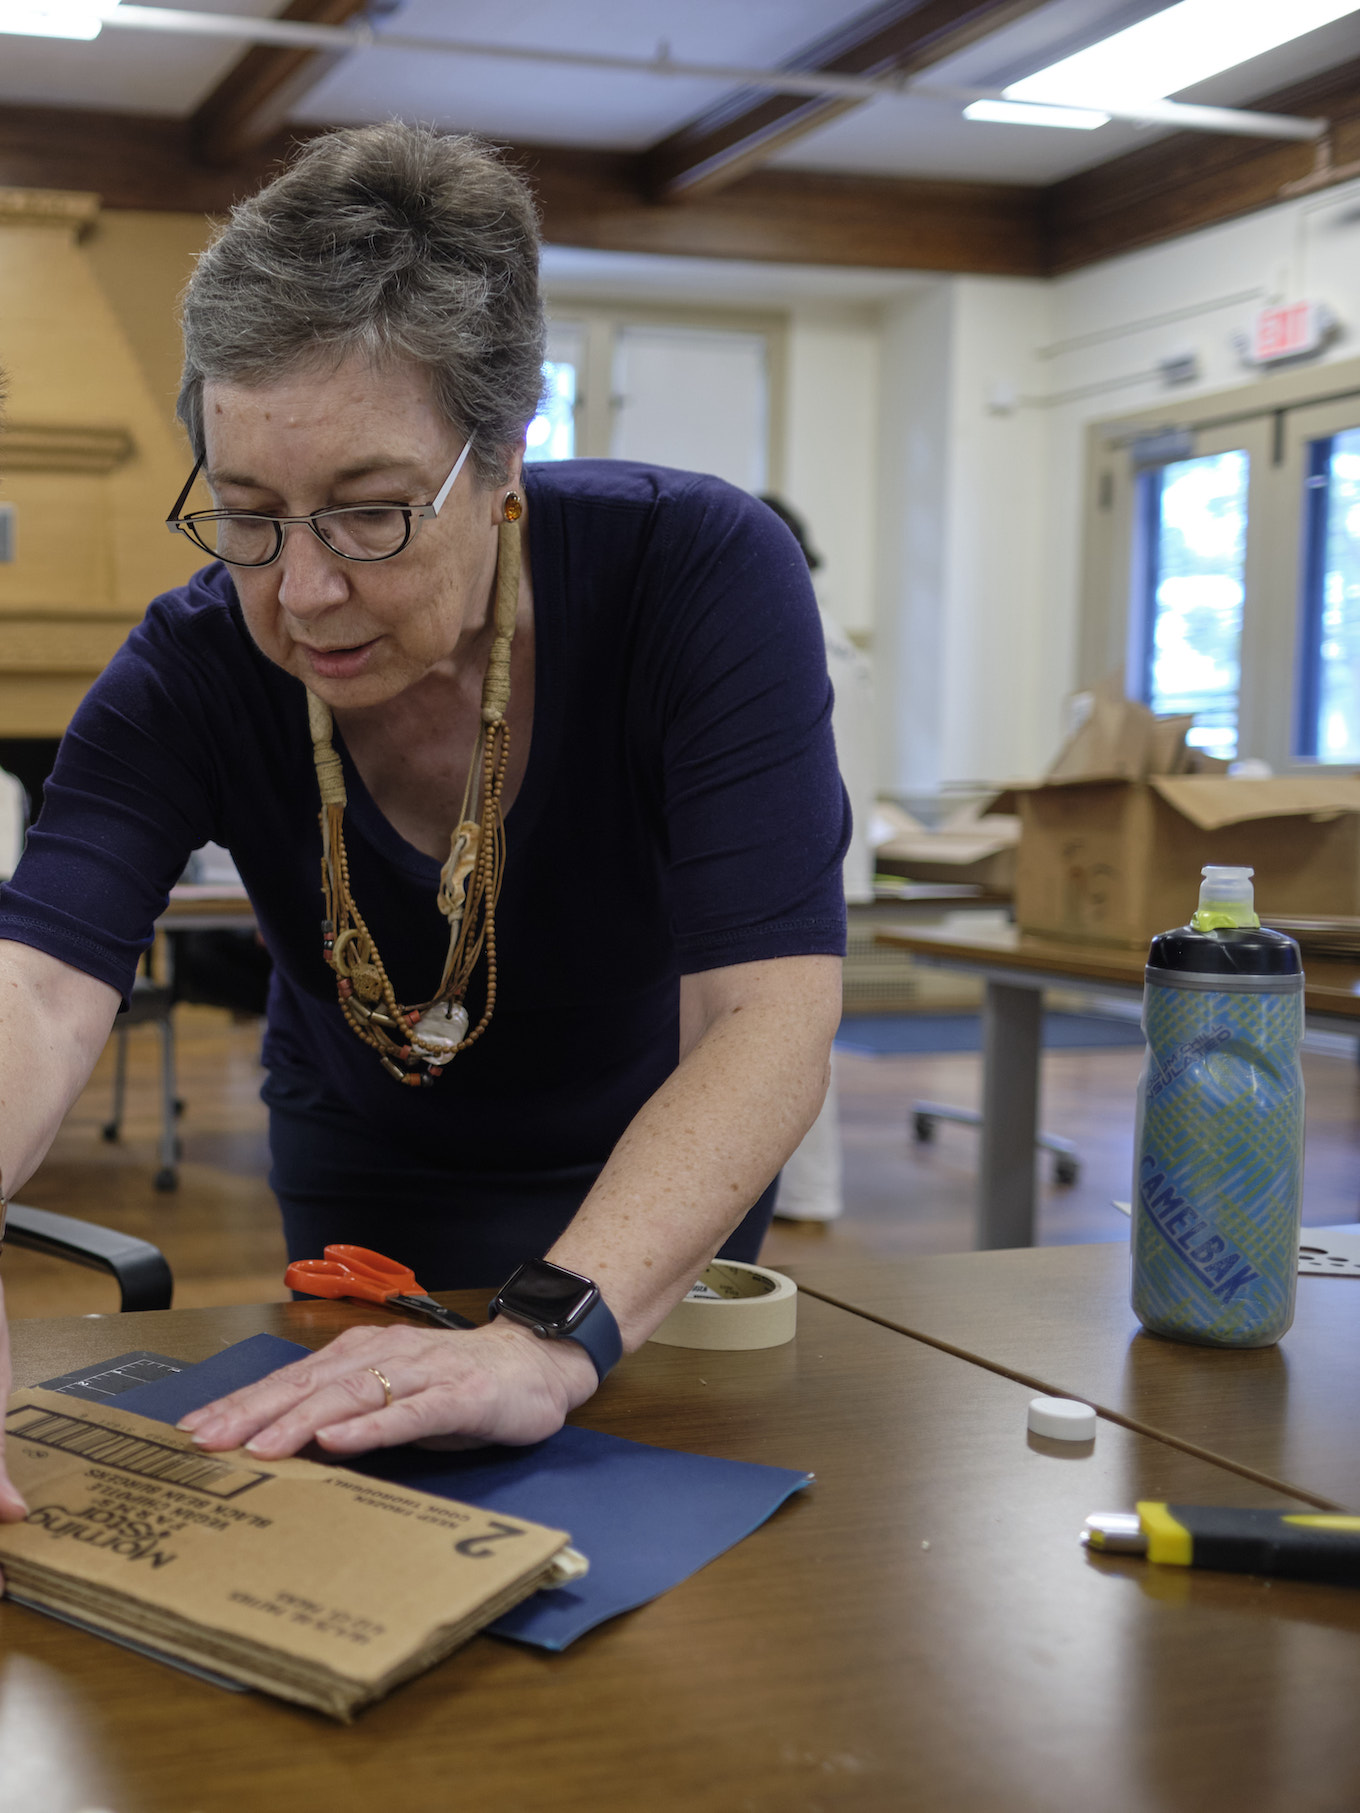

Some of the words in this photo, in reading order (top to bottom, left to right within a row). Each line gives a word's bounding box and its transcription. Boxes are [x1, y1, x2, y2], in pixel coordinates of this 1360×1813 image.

[84, 1468, 163, 1496] BURGERS
[323, 1477, 422, 1510] THOROUGHLY
[87, 1482, 171, 1512] CHIPOTLE
[160, 1488, 213, 1511] BEAN
[353, 1494, 415, 1517] FROZEN
[73, 1505, 155, 1540] Star
[171, 1506, 231, 1533] VEGAN
[214, 1505, 274, 1530] BLACK
[415, 1512, 460, 1530] KEEP
[425, 1504, 472, 1523] COOK
[24, 1504, 178, 1570] Morning
[454, 1520, 528, 1559] 2
